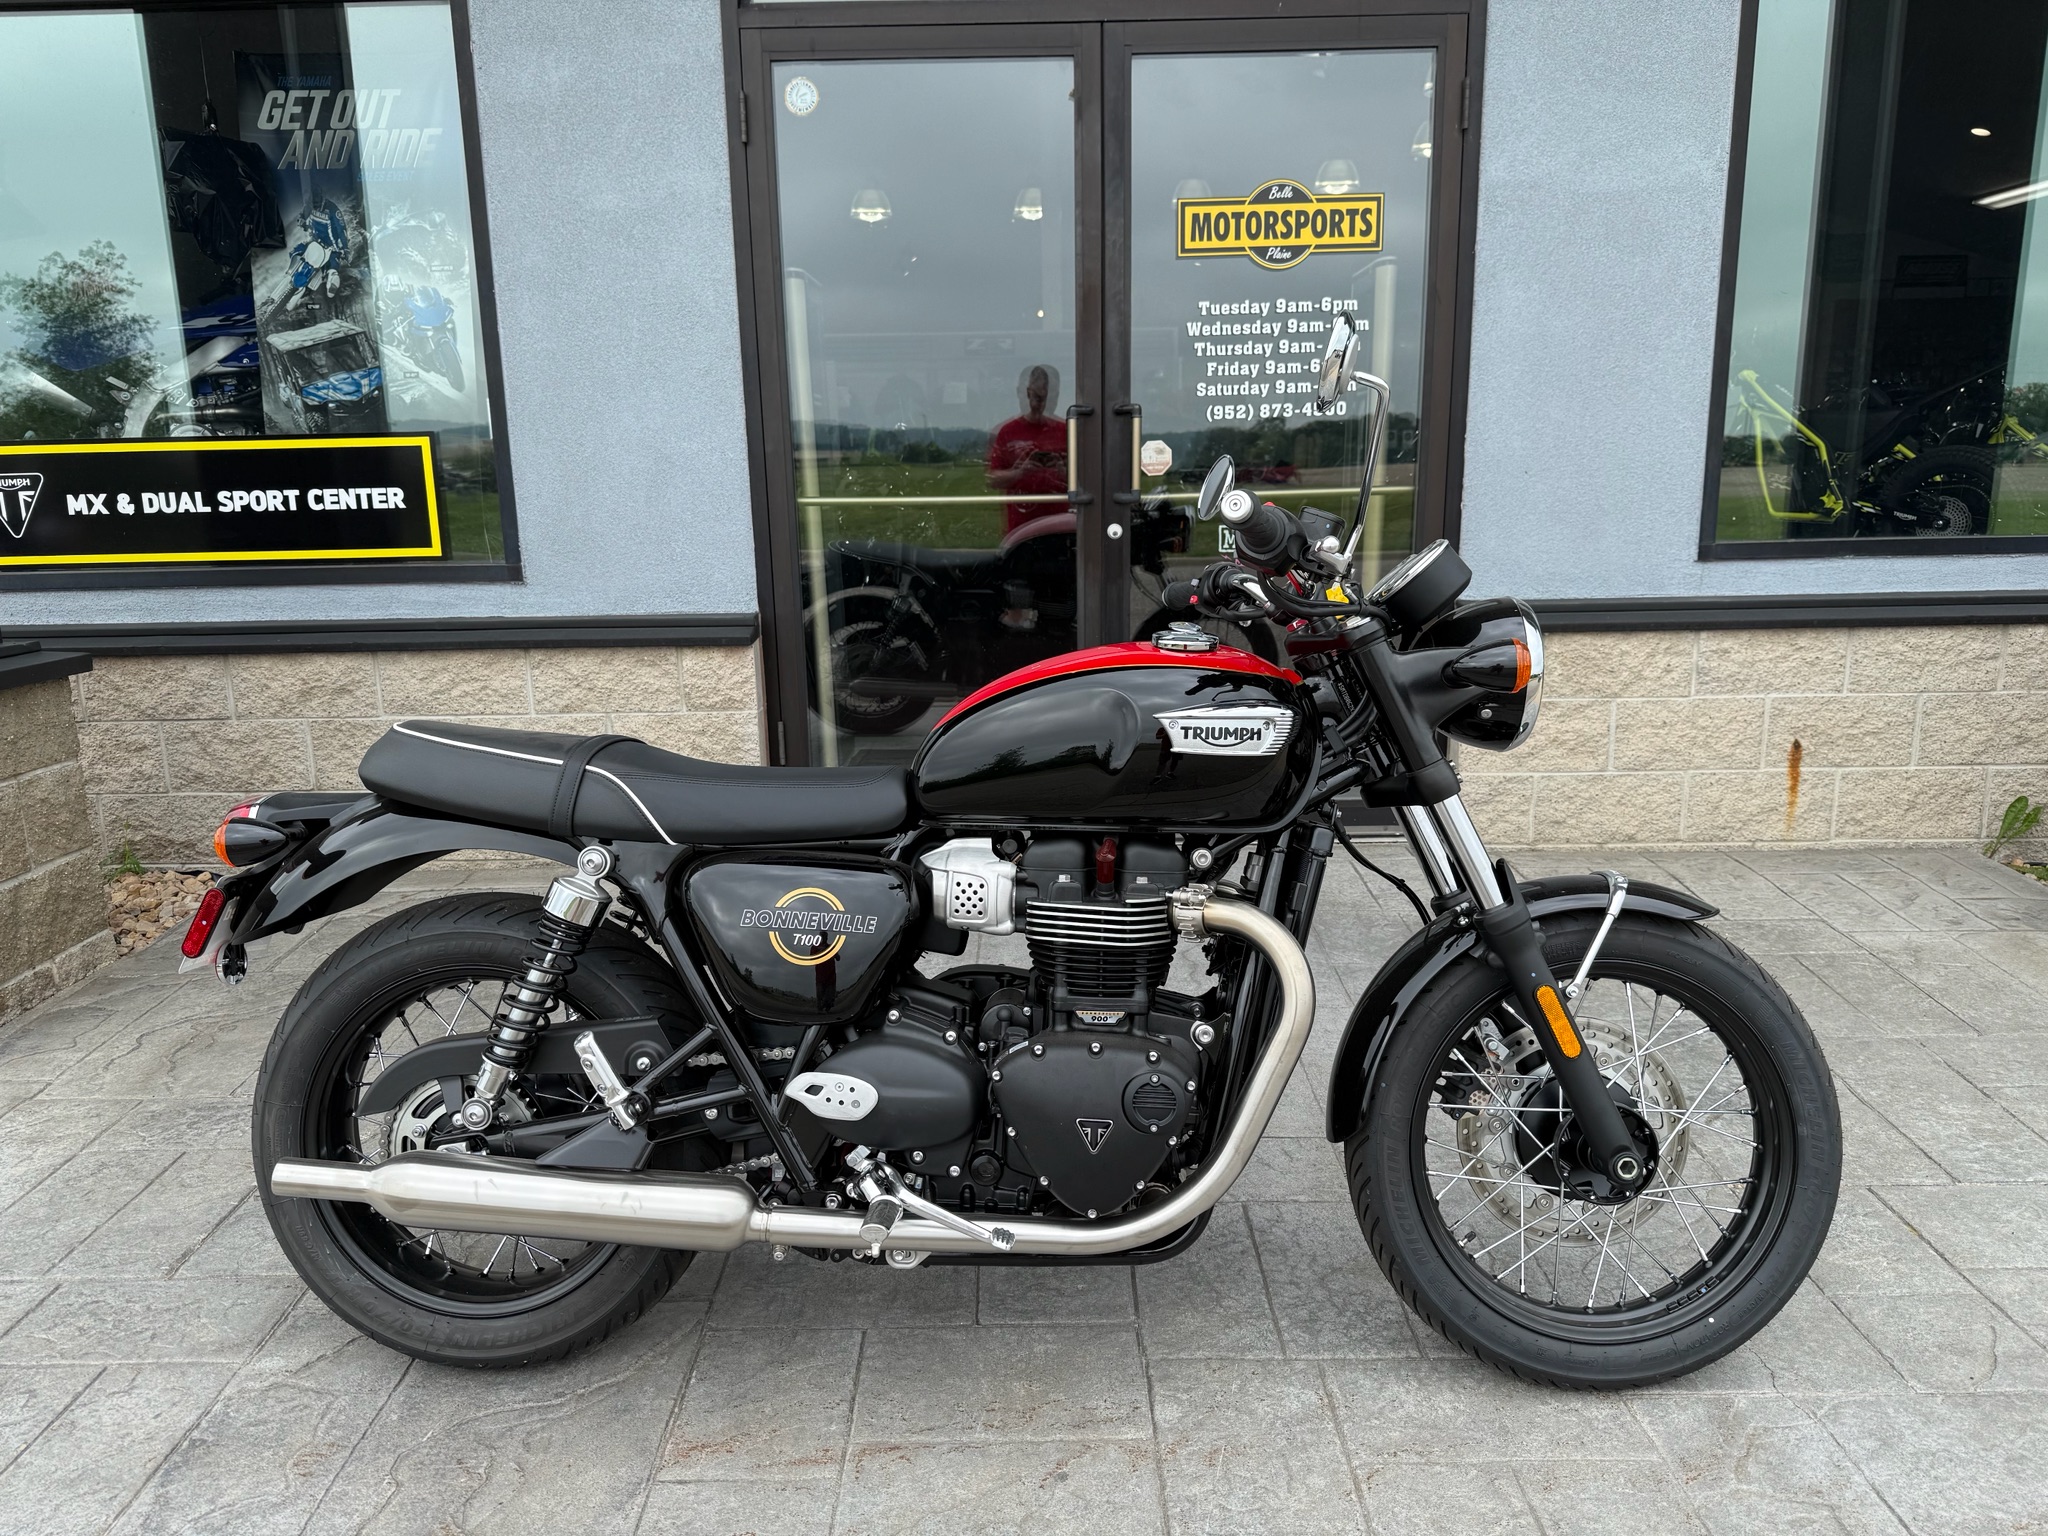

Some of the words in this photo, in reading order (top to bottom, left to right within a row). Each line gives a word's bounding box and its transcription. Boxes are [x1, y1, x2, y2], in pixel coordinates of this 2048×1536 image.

[295, 75, 332, 87] YAMAHA
[257, 89, 331, 130] GET
[329, 88, 401, 130] OUT
[277, 129, 356, 170] AND
[359, 128, 443, 169] RIDE
[1268, 186, 1293, 199] Belle
[1190, 207, 1373, 242] MOTORSPORTS
[1265, 246, 1292, 260] Plaine
[1198, 299, 1270, 317] Tuesday
[1276, 298, 1358, 315] 9am-6pm
[1186, 319, 1282, 337] Wednesday
[1287, 318, 1370, 333] 9am-m
[1194, 340, 1273, 358] Thursday
[1206, 361, 1260, 378] Friday
[1265, 359, 1325, 374] 9am-6
[1196, 381, 1270, 398] Saturday
[1275, 379, 1357, 394] 9am-m
[1206, 403, 1254, 422] (952)
[66, 493, 110, 516] MX
[116, 493, 135, 516] &
[141, 491, 212, 514] DUAL
[217, 489, 300, 513] SPORT
[307, 487, 407, 511] CENTER
[1180, 726, 1262, 747] TRIUMPH
[740, 909, 878, 934] BONNEVILLE
[793, 933, 822, 947] T100
[1091, 1015, 1109, 1023] 900
[1781, 1040, 1826, 1163] MICHELIN
[1385, 1144, 1432, 1267] MICHELIN
